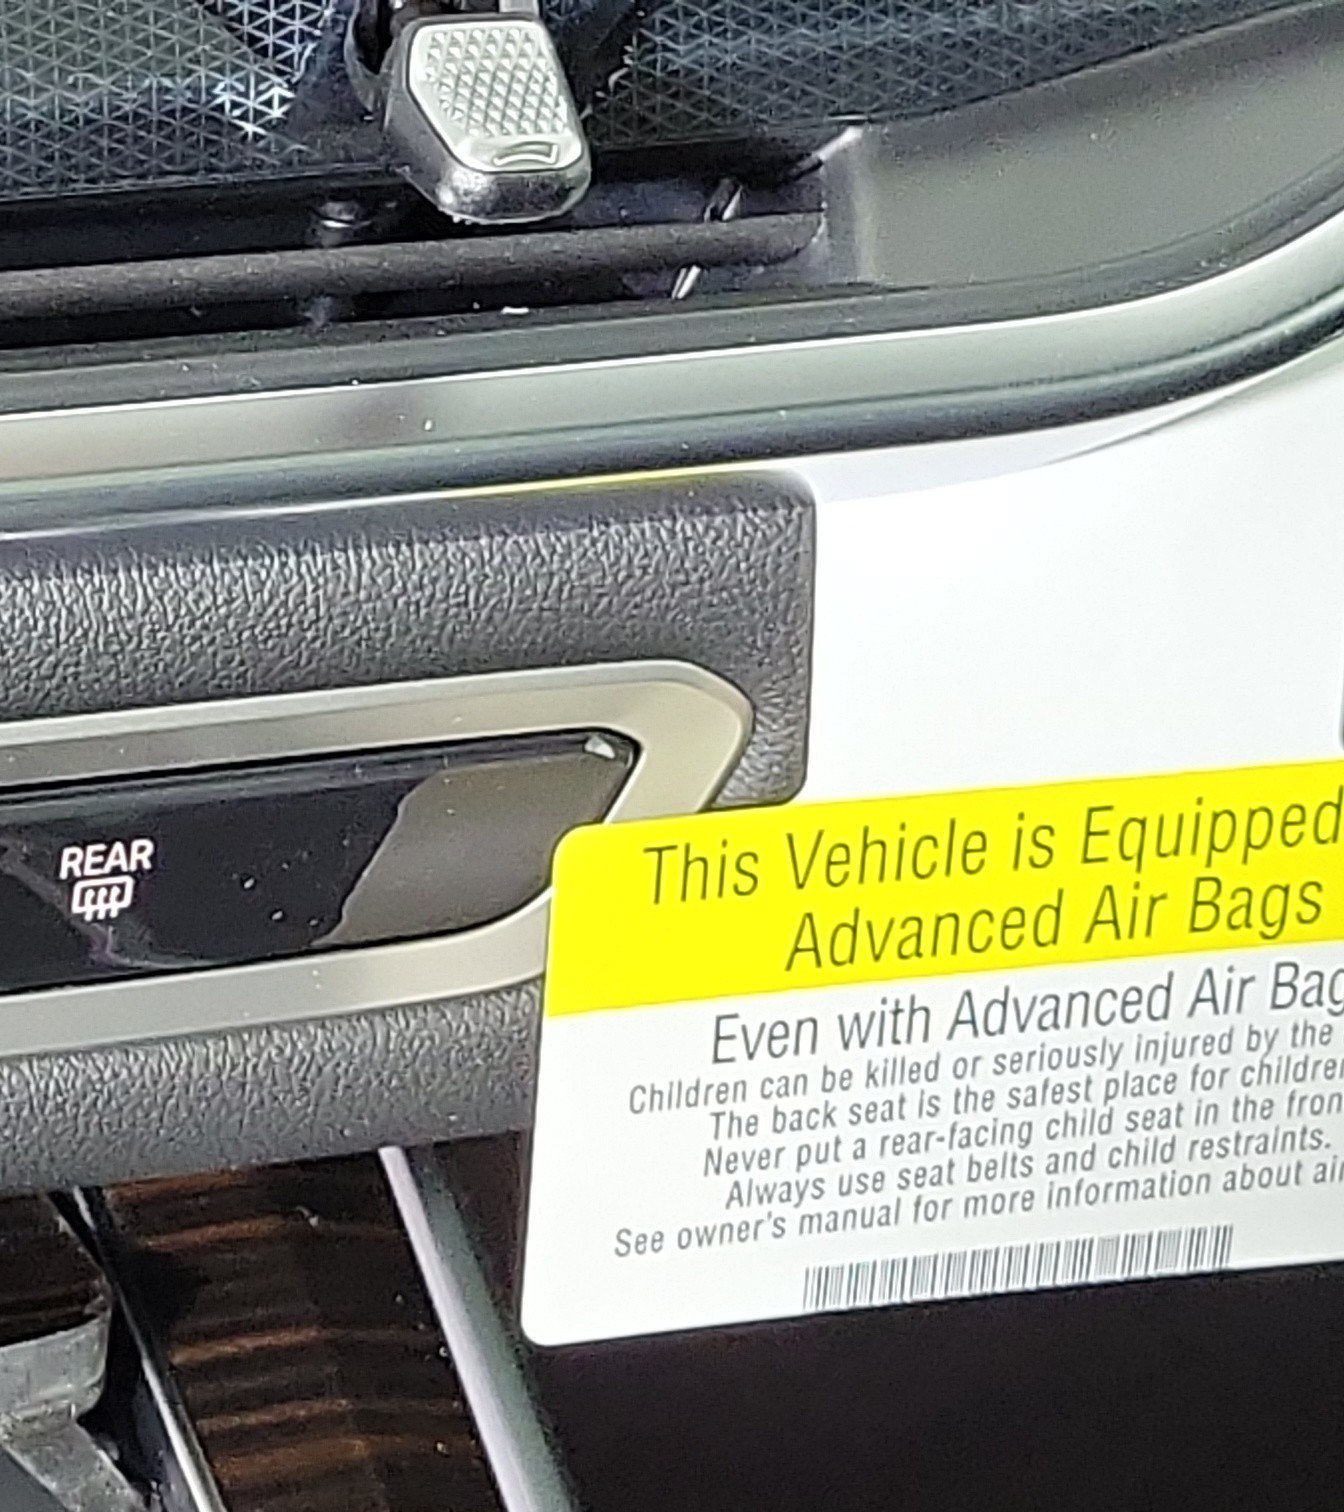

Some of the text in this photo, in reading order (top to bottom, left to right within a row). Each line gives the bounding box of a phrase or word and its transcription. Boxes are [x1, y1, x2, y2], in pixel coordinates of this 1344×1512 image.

[59, 838, 155, 880] REAR
[643, 784, 1344, 905] This Vehicle is Equipped
[784, 876, 1323, 972] Advanced Air Bags
[712, 1012, 818, 1065] Even
[837, 994, 931, 1051] with
[946, 970, 1175, 1041] Advanced
[1186, 965, 1256, 1019] Air
[629, 1018, 1335, 1115] Children can be killed or seriously injured by the
[709, 1110, 759, 1141] The
[772, 1099, 837, 1134] back
[848, 1093, 906, 1126] seat
[918, 1089, 941, 1119] is
[953, 1084, 996, 1115] the
[1006, 1075, 1093, 1110] safest
[1103, 1069, 1178, 1107] place
[1190, 1062, 1231, 1092] for
[703, 1146, 786, 1177] Never
[796, 1135, 842, 1173] put
[851, 1136, 868, 1162] a
[879, 1117, 1033, 1157] rear-facing
[1045, 1106, 1114, 1141] child
[1124, 1101, 1185, 1133] seat
[1194, 1098, 1219, 1127] in
[1232, 1094, 1275, 1124] the
[725, 1124, 1332, 1210] Always use seat belts and child restraints.
[614, 1228, 665, 1258] See
[677, 1211, 786, 1250] owner's
[798, 1197, 901, 1235] manual
[913, 1194, 953, 1223] for
[963, 1189, 1035, 1218] more
[1047, 1169, 1212, 1210] information
[1222, 1159, 1304, 1193] about
